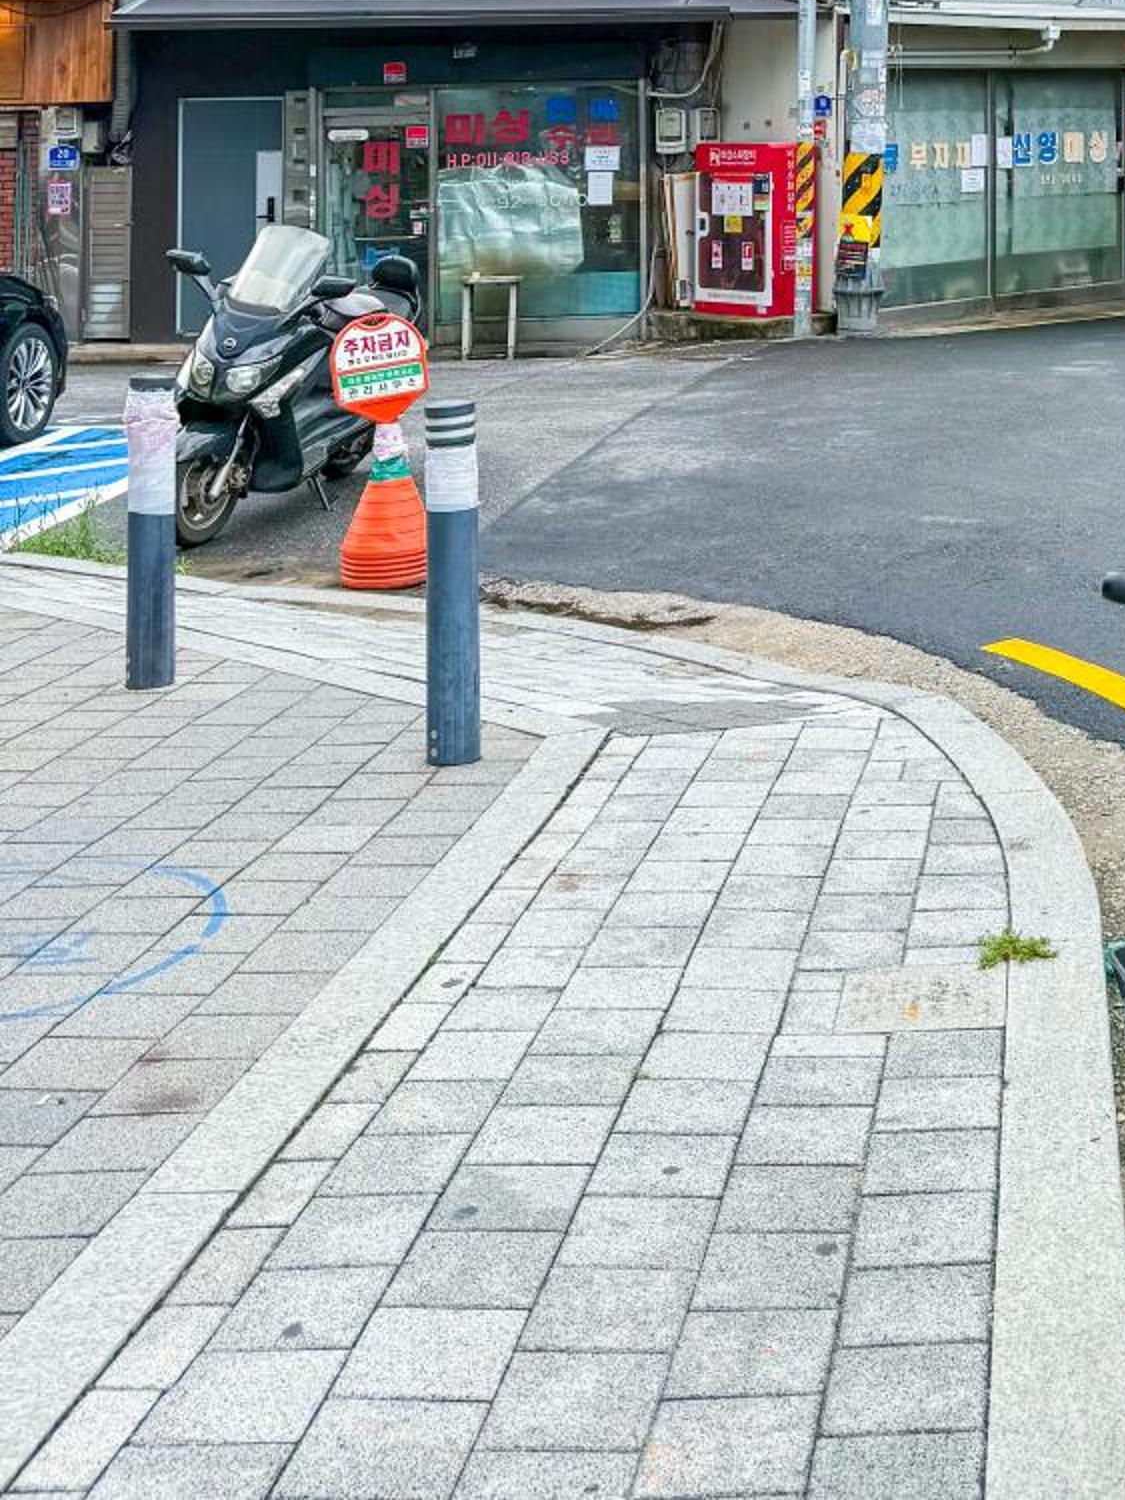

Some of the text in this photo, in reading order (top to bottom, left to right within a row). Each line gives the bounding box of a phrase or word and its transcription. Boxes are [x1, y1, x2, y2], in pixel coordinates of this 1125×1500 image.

[444, 110, 530, 146] 미싱
[362, 140, 400, 221] 미싱
[343, 329, 411, 357] 주차금지
